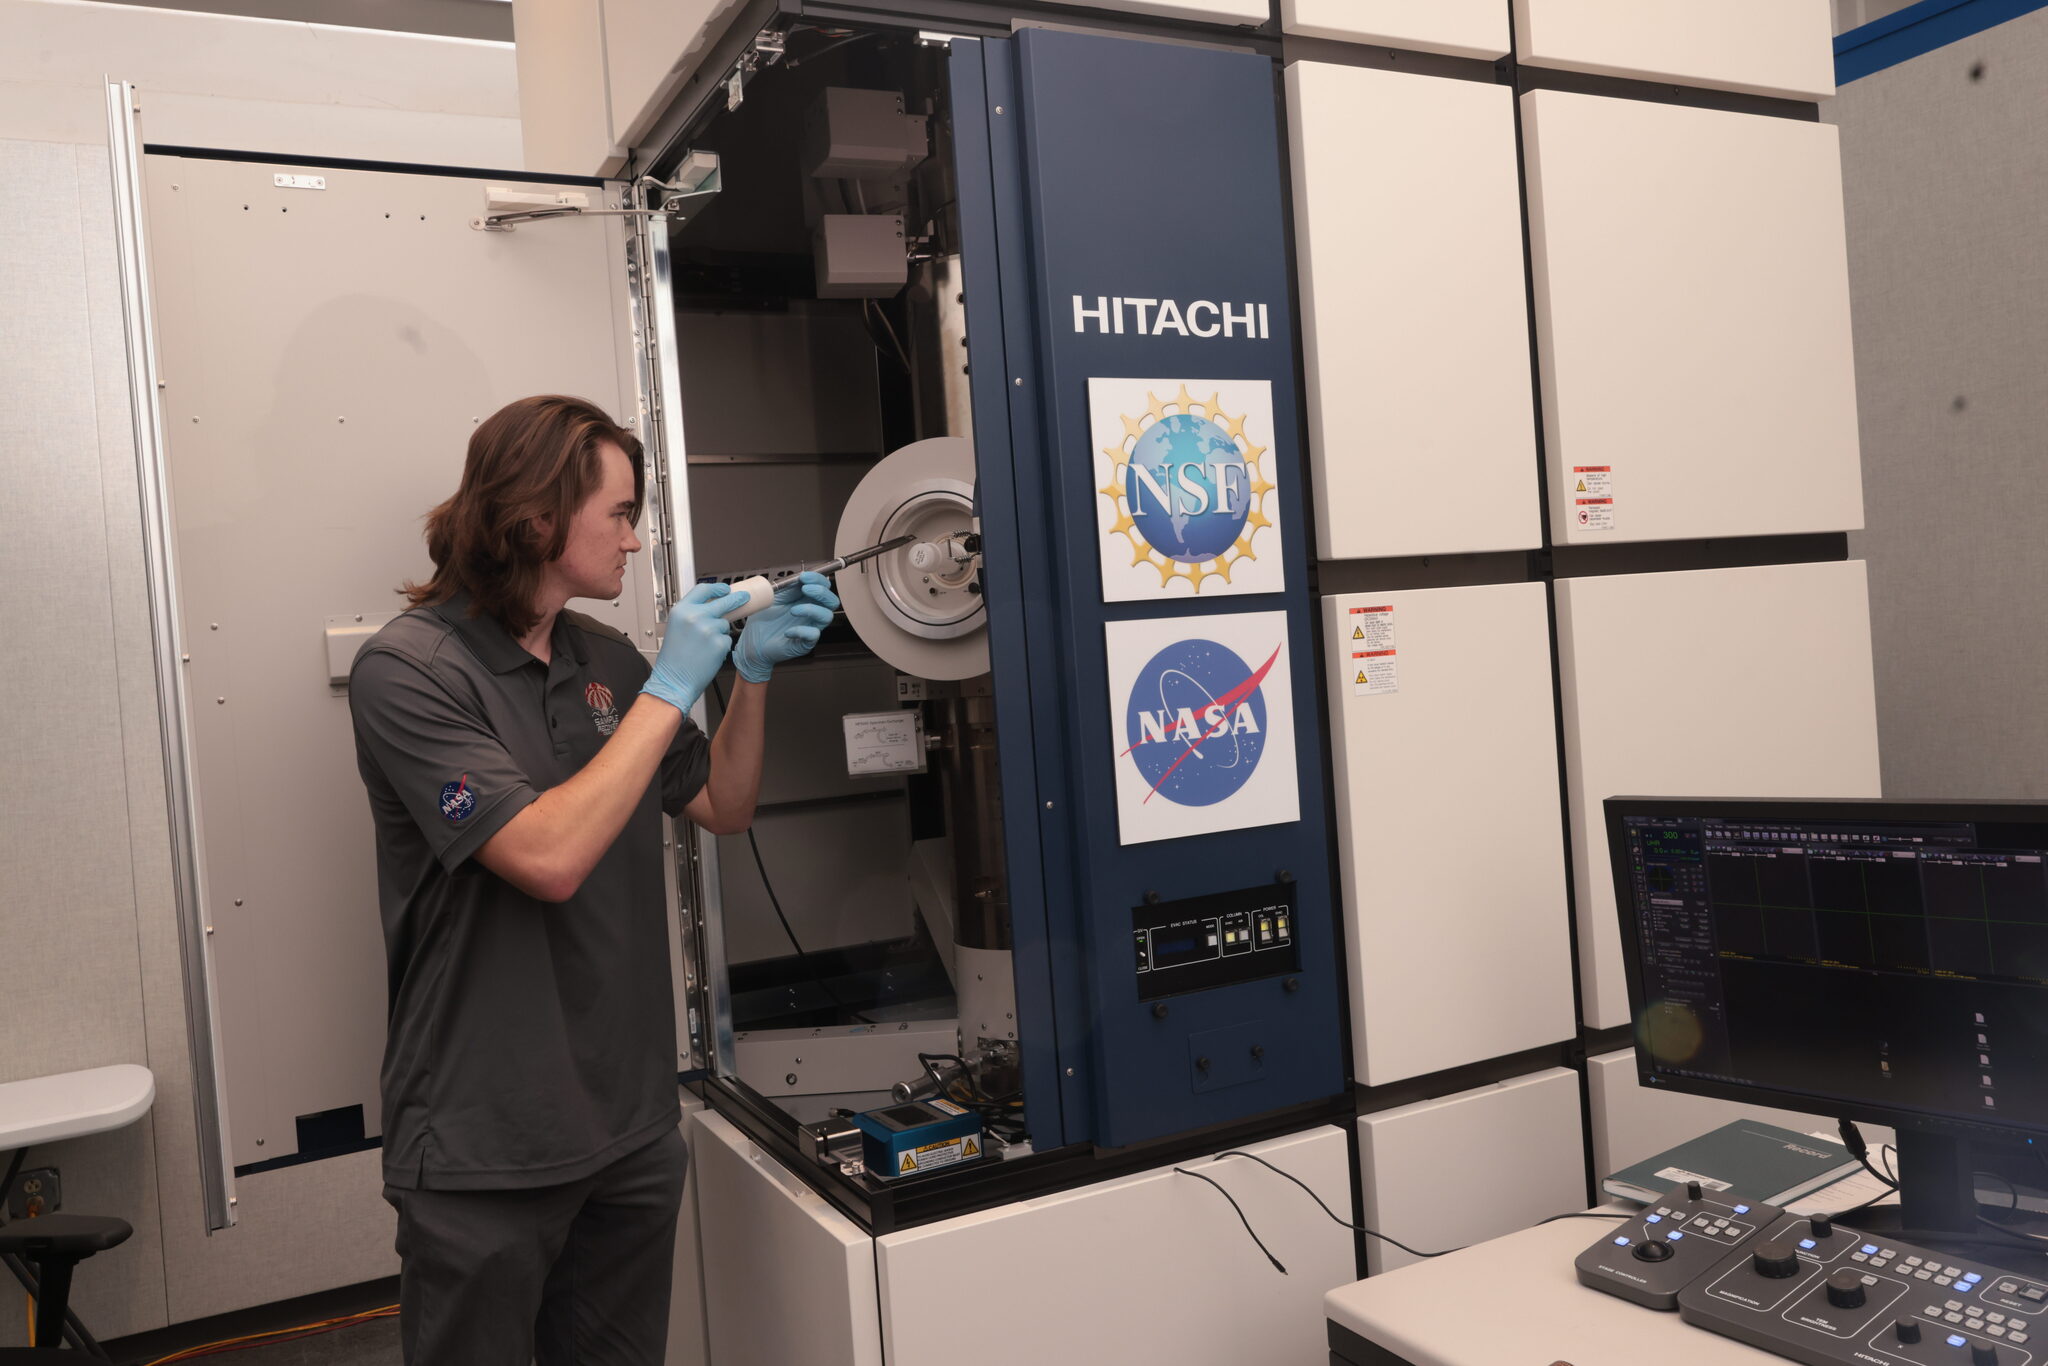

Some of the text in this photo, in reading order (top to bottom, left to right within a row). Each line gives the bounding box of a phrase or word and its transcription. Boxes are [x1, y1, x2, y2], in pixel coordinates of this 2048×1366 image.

[1072, 295, 1270, 339] HITACHI
[1128, 461, 1249, 518] NSF
[594, 714, 619, 726] SAMPLE
[1138, 702, 1260, 745] NASA
[441, 789, 472, 814] NASA
[1663, 831, 1679, 839] 300
[928, 1141, 951, 1150] CAUTION
[1783, 1143, 1832, 1159] Record
[1598, 1264, 1648, 1284] STAGE CONTROLLER
[1719, 1289, 1760, 1306] MAGNIFICATION
[2000, 1298, 2022, 1307] RESET
[1800, 1316, 1837, 1331] BRIGHTNESS
[1853, 1351, 1890, 1366] HITACHI
